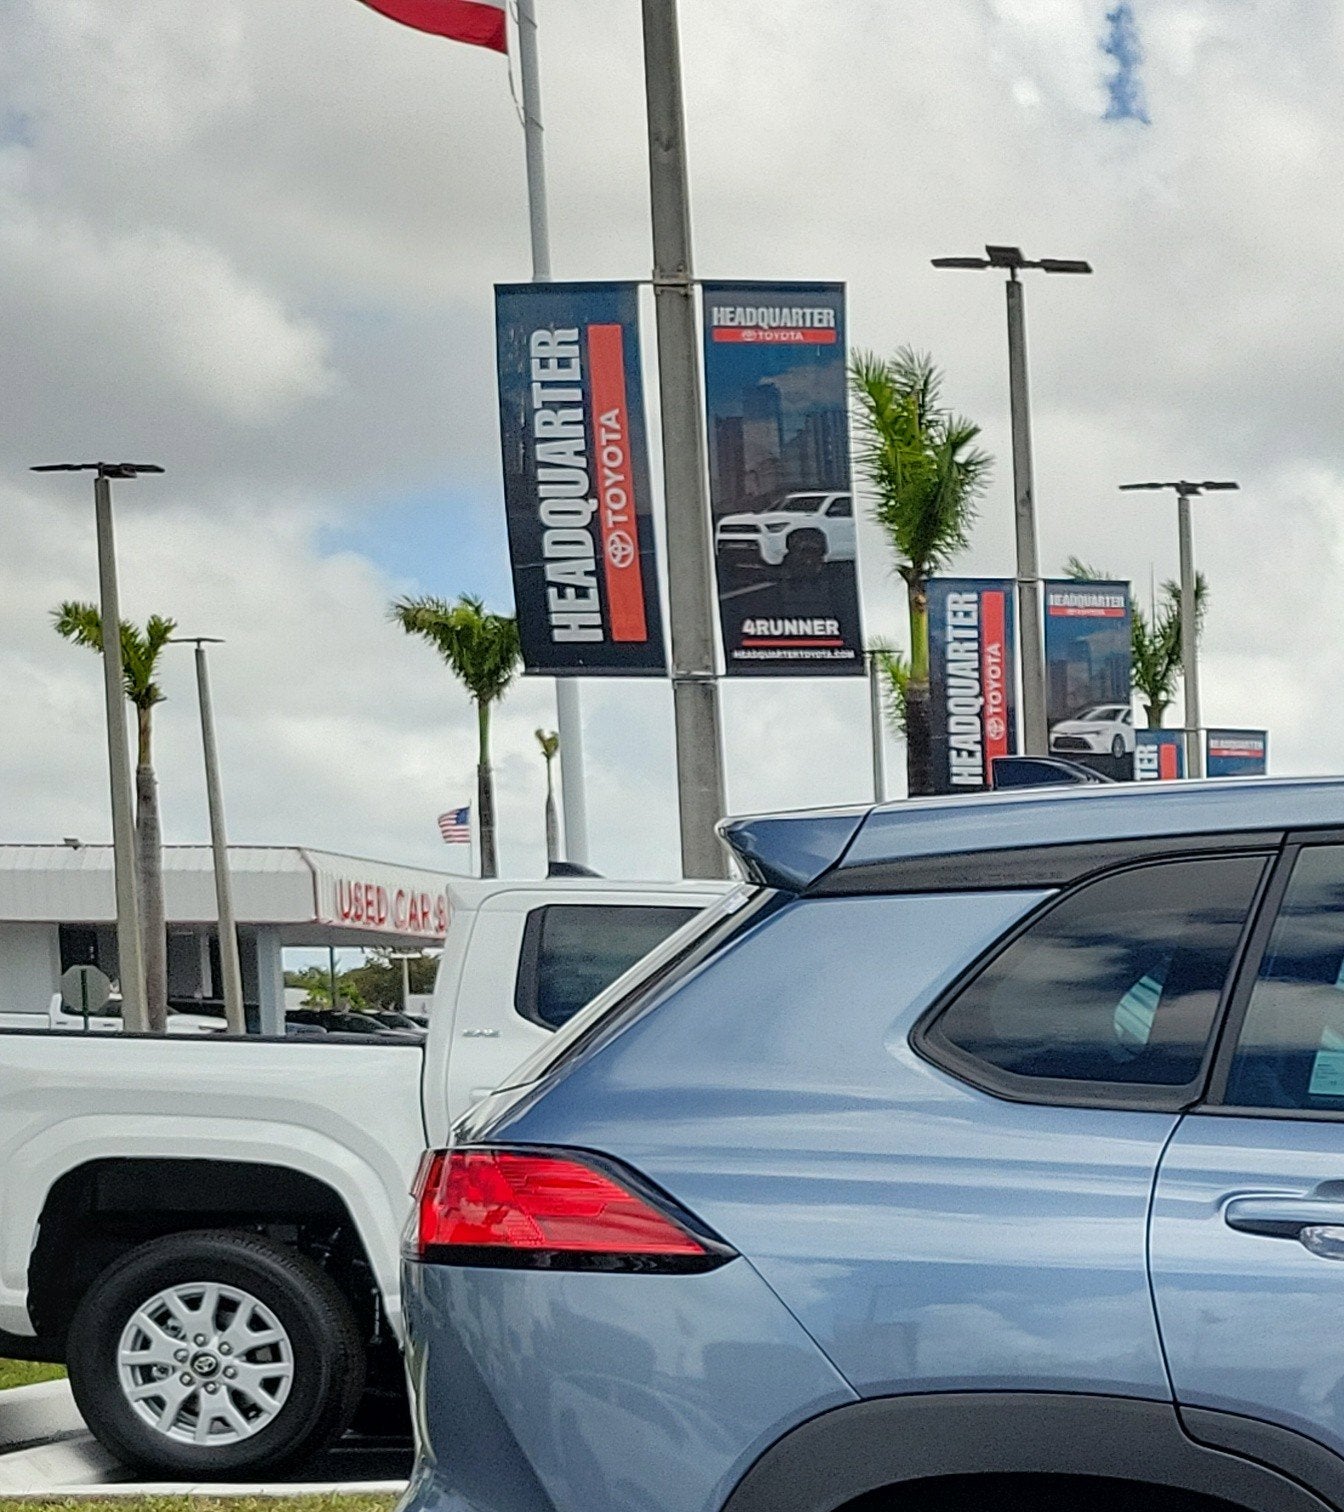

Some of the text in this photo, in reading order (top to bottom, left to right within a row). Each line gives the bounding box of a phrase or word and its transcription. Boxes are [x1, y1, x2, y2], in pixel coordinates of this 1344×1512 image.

[712, 307, 835, 329] HEADQUARTER
[759, 331, 804, 341] TOYOTA
[530, 327, 605, 643] HEADQUARTER
[599, 408, 630, 528] TOYOTA
[741, 618, 840, 636] 4RUNNER
[946, 591, 984, 786] HEADQUARTER
[986, 643, 1002, 715] TOYOTA
[338, 879, 388, 925] USED
